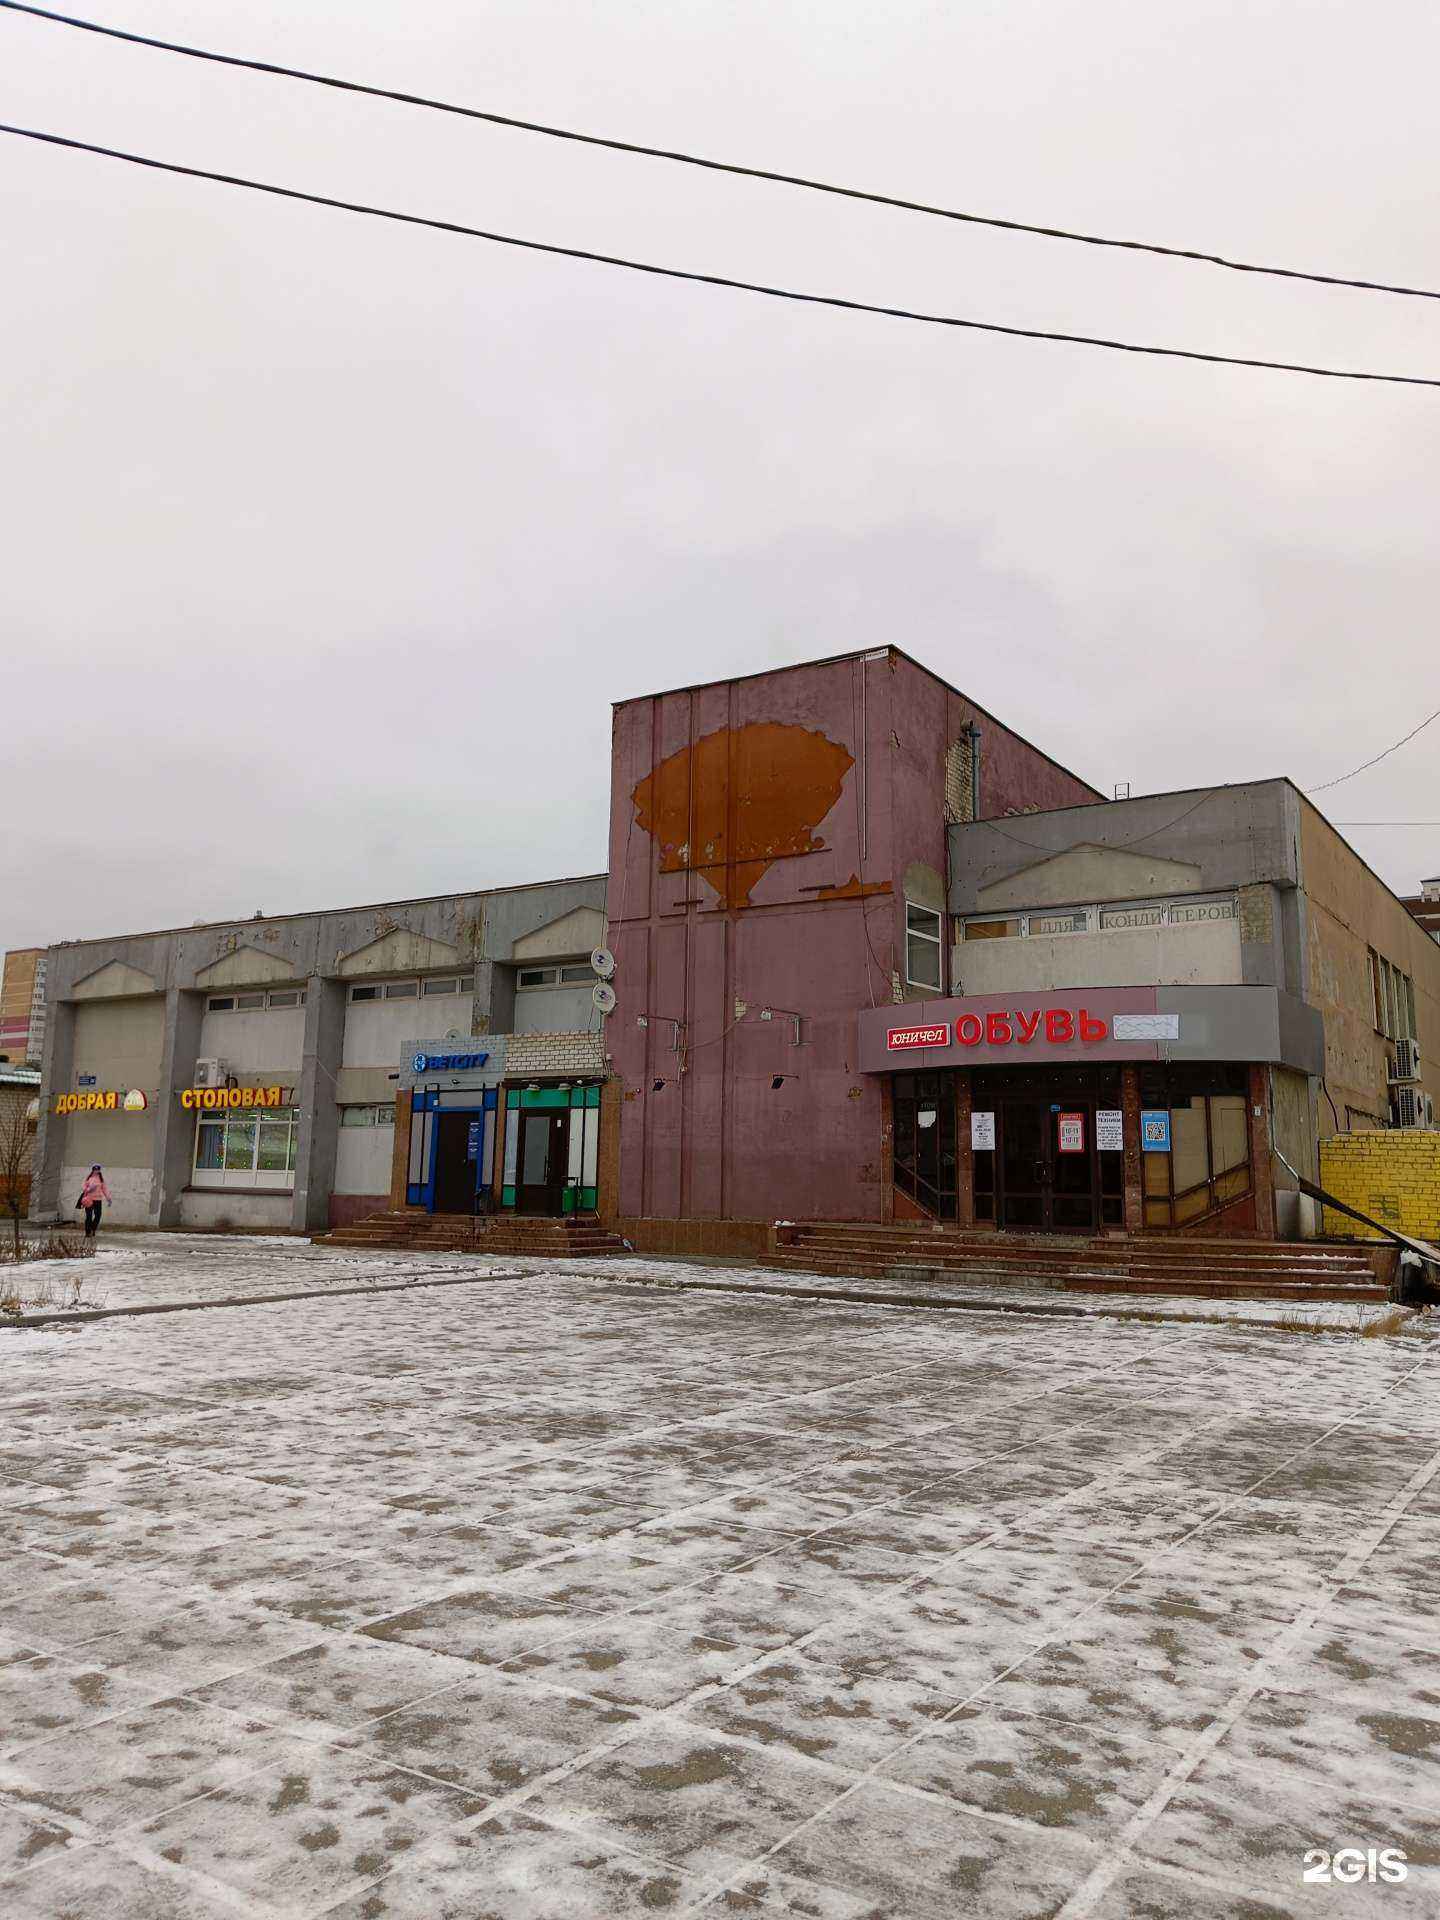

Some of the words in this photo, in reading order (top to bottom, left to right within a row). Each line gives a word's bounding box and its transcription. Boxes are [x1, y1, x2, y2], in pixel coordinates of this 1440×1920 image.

[954, 1009, 1108, 1046] ОБУВЬ
[56, 1092, 118, 1114] ДОБРАЯ
[181, 1087, 282, 1109] СТОЛОВАЯ
